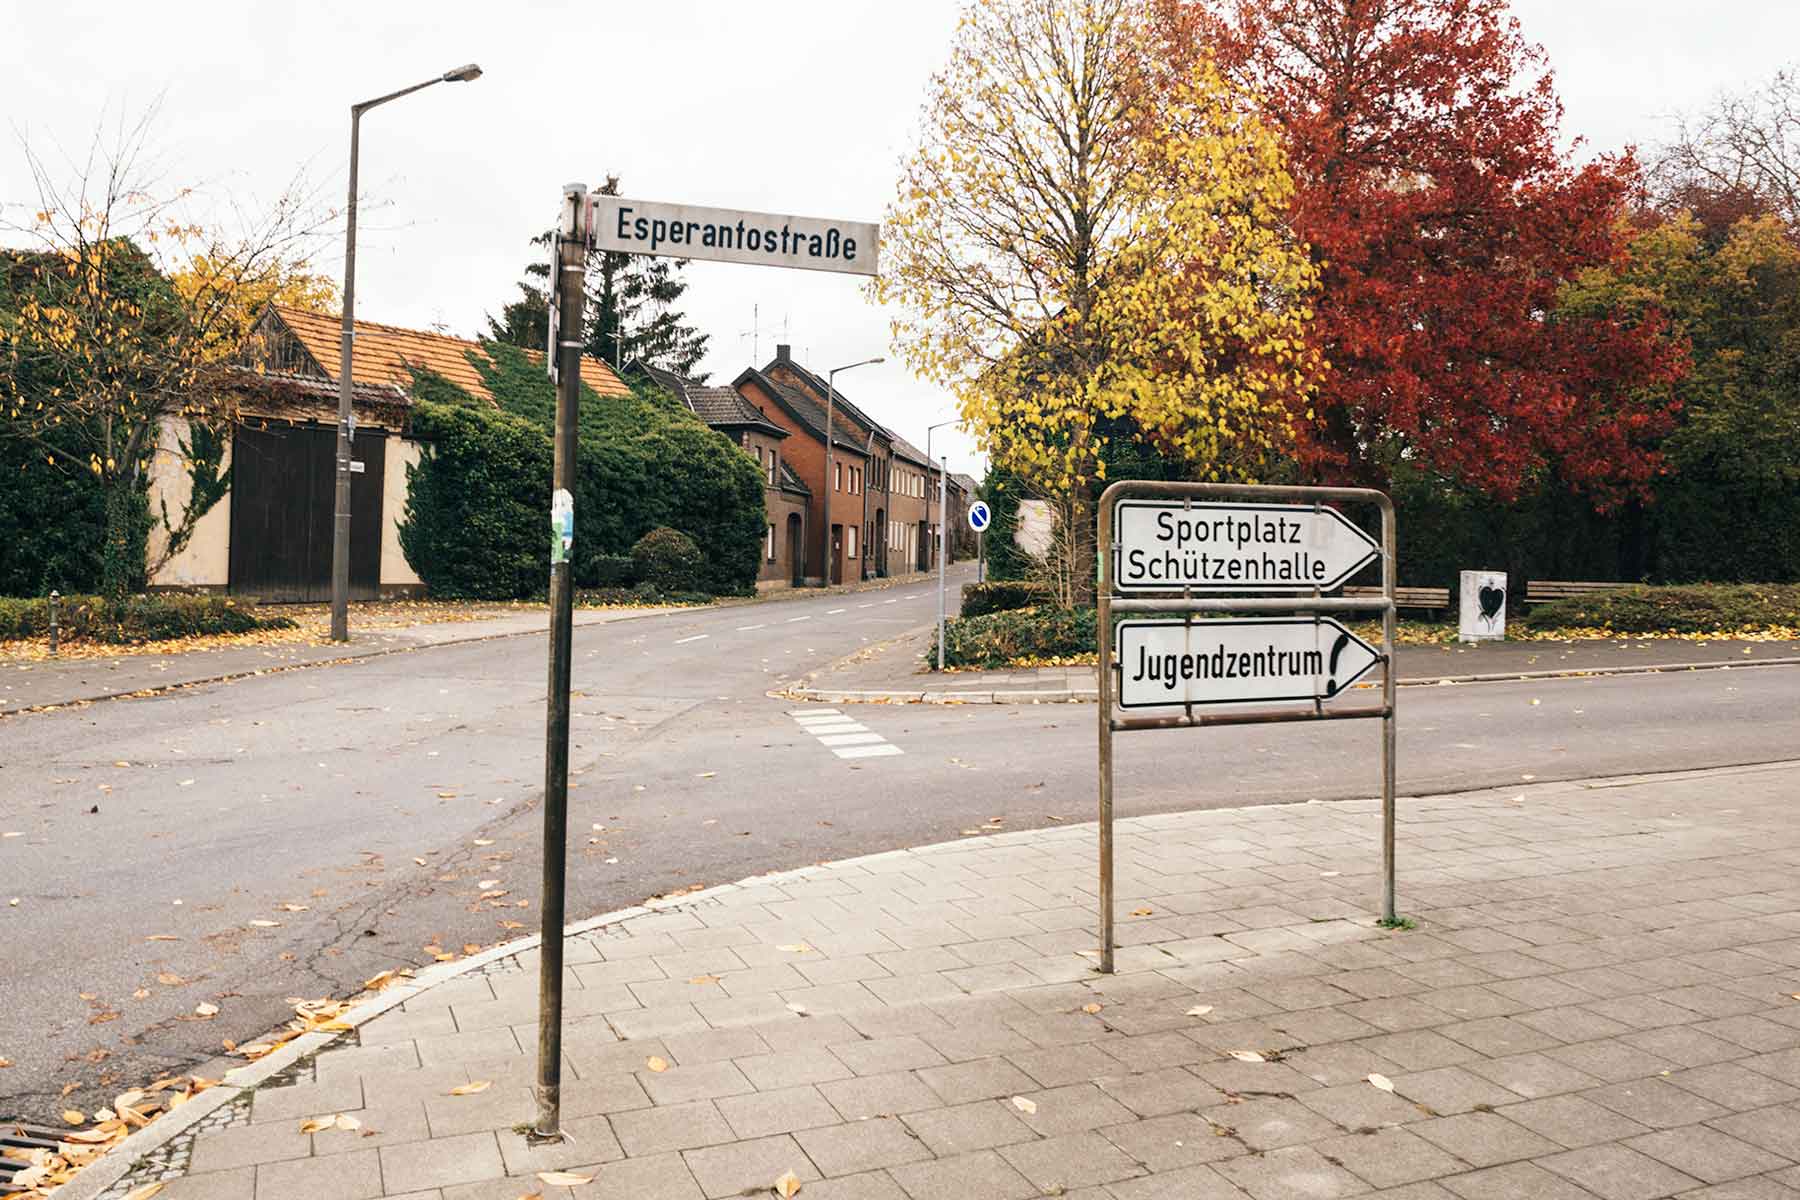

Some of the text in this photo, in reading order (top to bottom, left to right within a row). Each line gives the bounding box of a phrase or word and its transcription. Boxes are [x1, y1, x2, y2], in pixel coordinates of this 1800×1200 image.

[617, 207, 857, 260] Esperantostraße
[1156, 511, 1301, 550] Sportplatz
[1128, 550, 1326, 580] Schützenhalle
